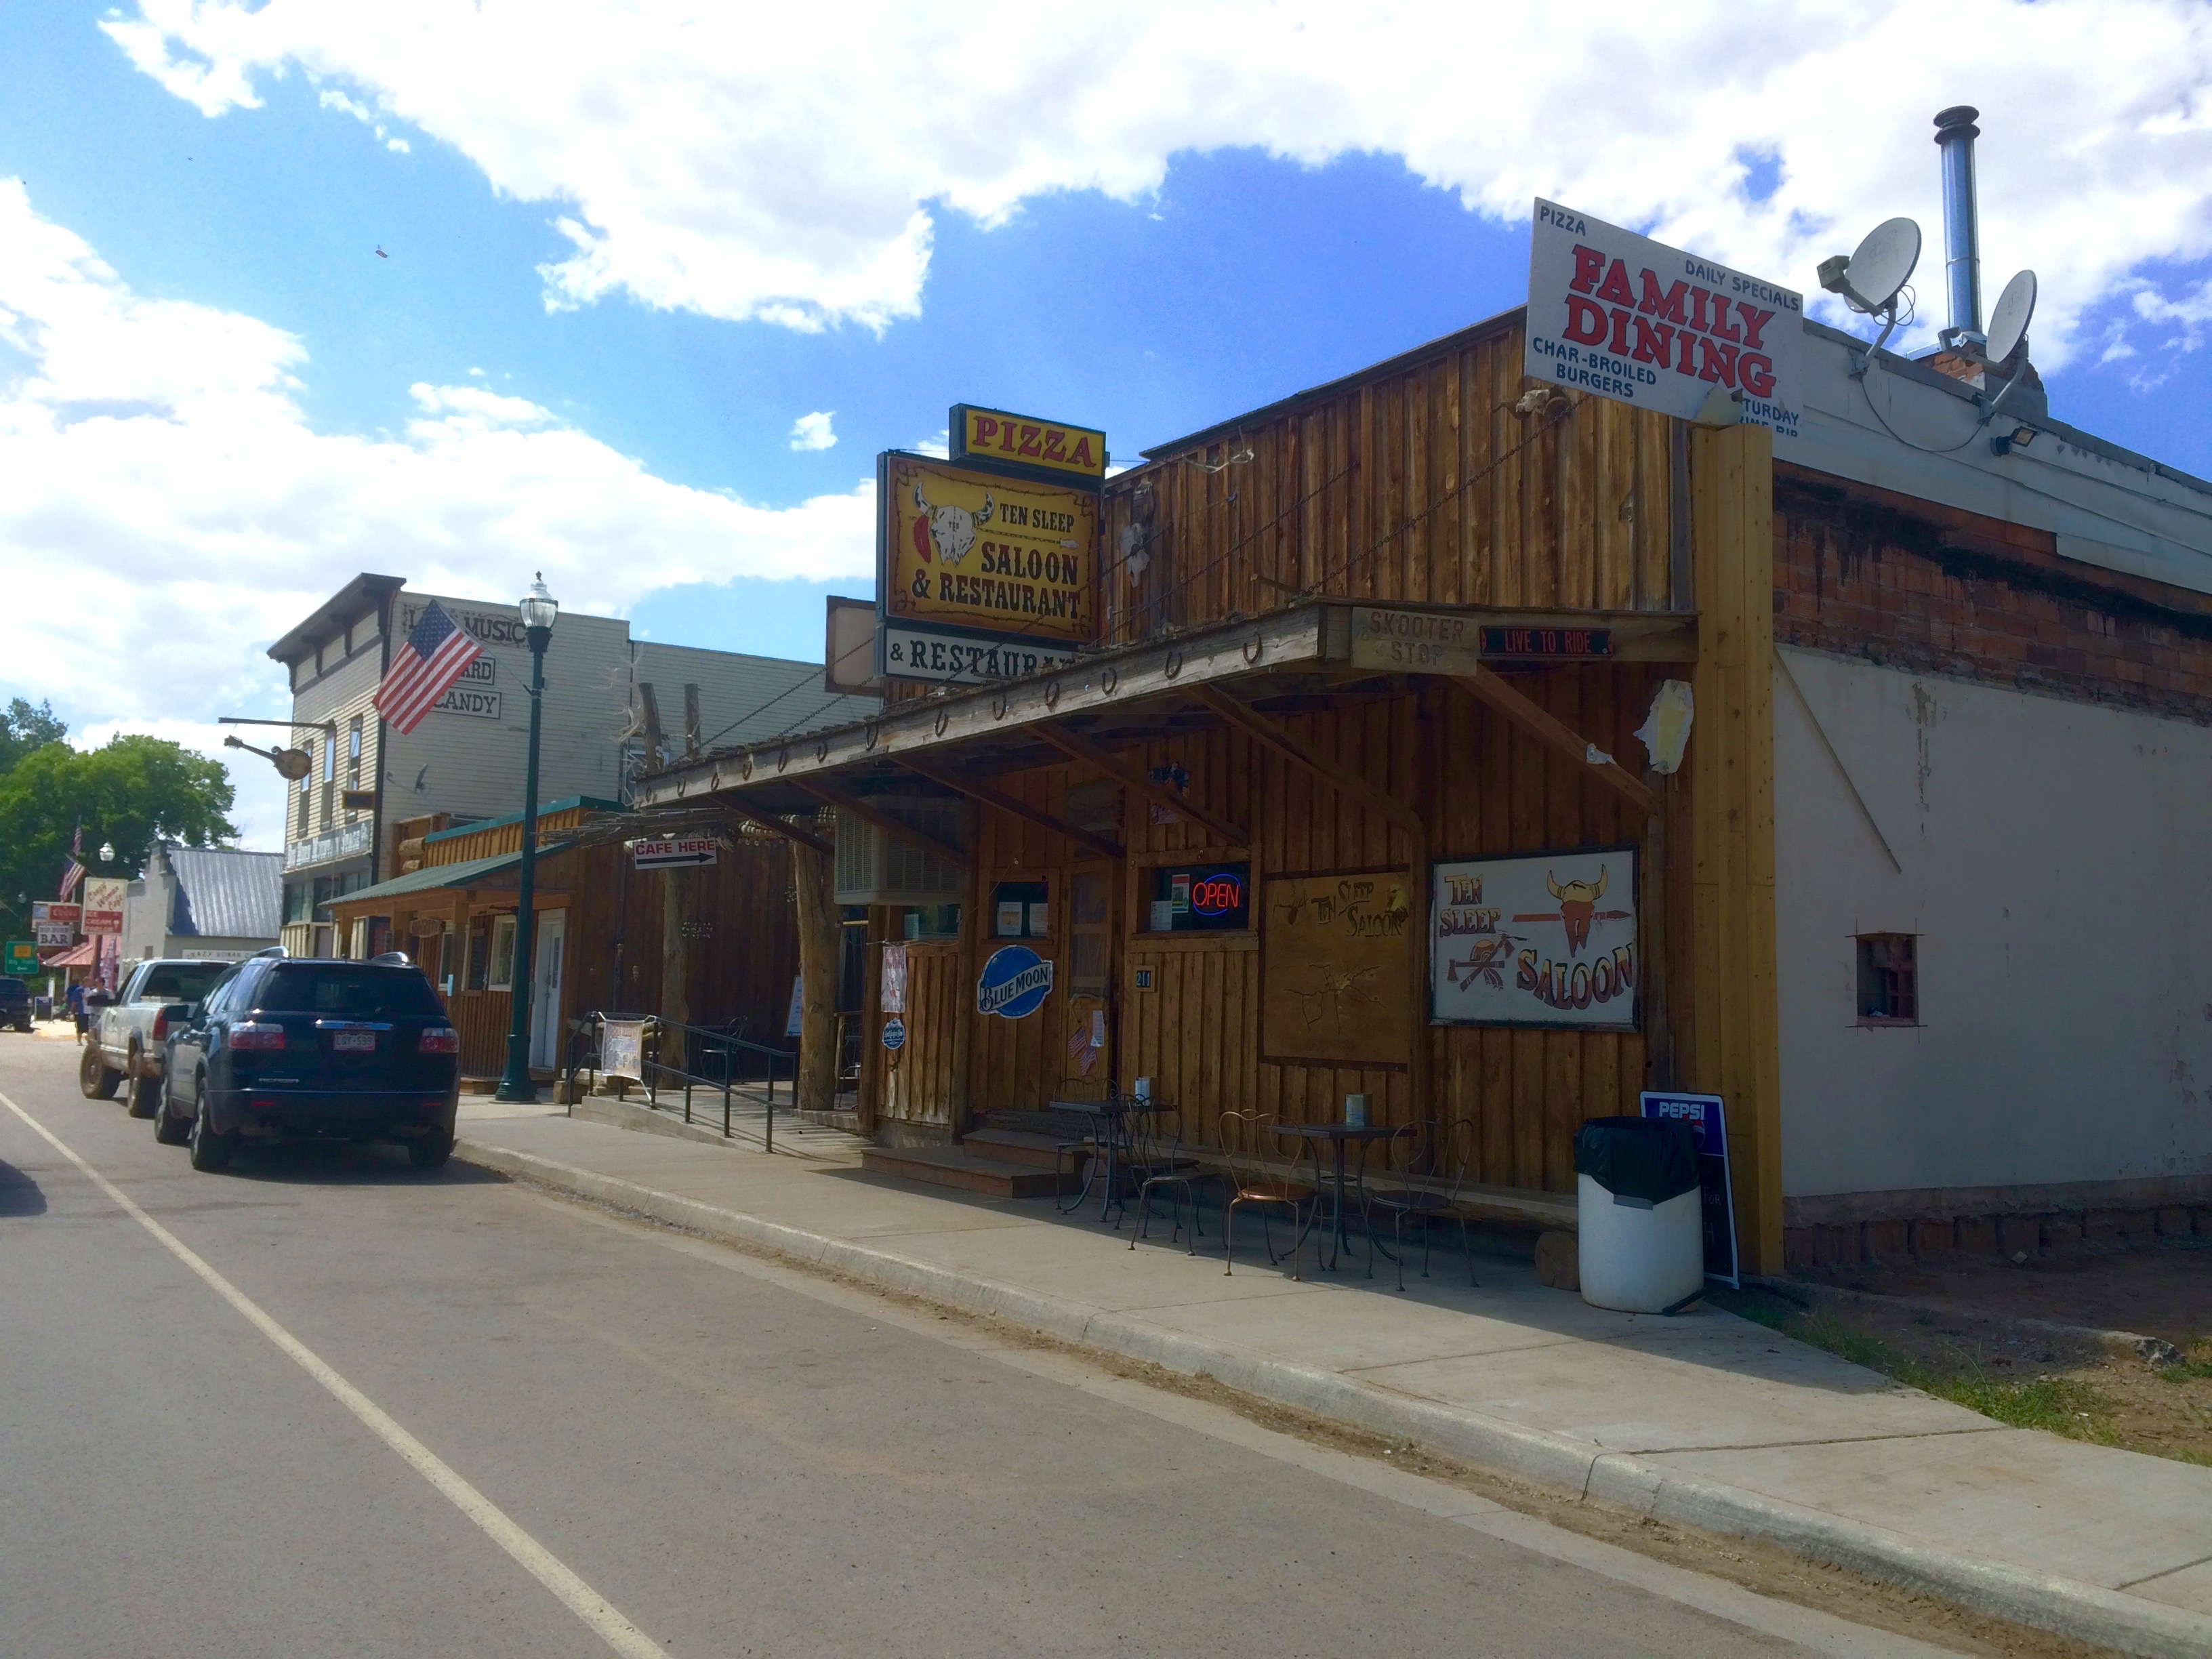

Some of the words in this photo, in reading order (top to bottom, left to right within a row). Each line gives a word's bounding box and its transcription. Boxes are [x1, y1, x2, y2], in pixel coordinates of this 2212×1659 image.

[1540, 206, 1586, 237] PIZZA
[1570, 244, 1776, 350] FAMILY
[1685, 260, 1726, 285] DAILY
[1732, 276, 1799, 311] SPECIALS
[1562, 293, 1777, 398] DINING
[1556, 363, 1633, 398] BURGERS
[1743, 398, 1799, 426] TURDAY
[972, 415, 1097, 468] PIZZA
[1000, 503, 1027, 527] TEN
[1033, 509, 1074, 533] SLEEP
[981, 541, 1079, 586] SALOON
[912, 569, 931, 599] &
[940, 572, 1080, 619] RESTAURANT
[464, 616, 527, 643] MUSIC
[1370, 611, 1465, 642] SKOOTER
[1505, 630, 1531, 653] LIVE
[1541, 631, 1556, 653] TO
[1564, 631, 1591, 653] RIDE
[890, 642, 904, 661] &
[910, 640, 1076, 676] RESTAUR
[1391, 640, 1443, 666] STOP
[461, 661, 492, 680] ARD
[636, 842, 672, 855] CAFE
[678, 840, 715, 852] HERE
[1193, 882, 1240, 908] OPEN
[1444, 873, 1483, 905] TEN
[1439, 908, 1501, 938] SLEEP
[40, 934, 68, 944] BAR
[980, 982, 1014, 1011] BLUE
[1017, 966, 1049, 994] MOON
[1136, 971, 1151, 987] 211
[1516, 942, 1633, 1010] SALOON
[1659, 1101, 1705, 1121] PEPSI
